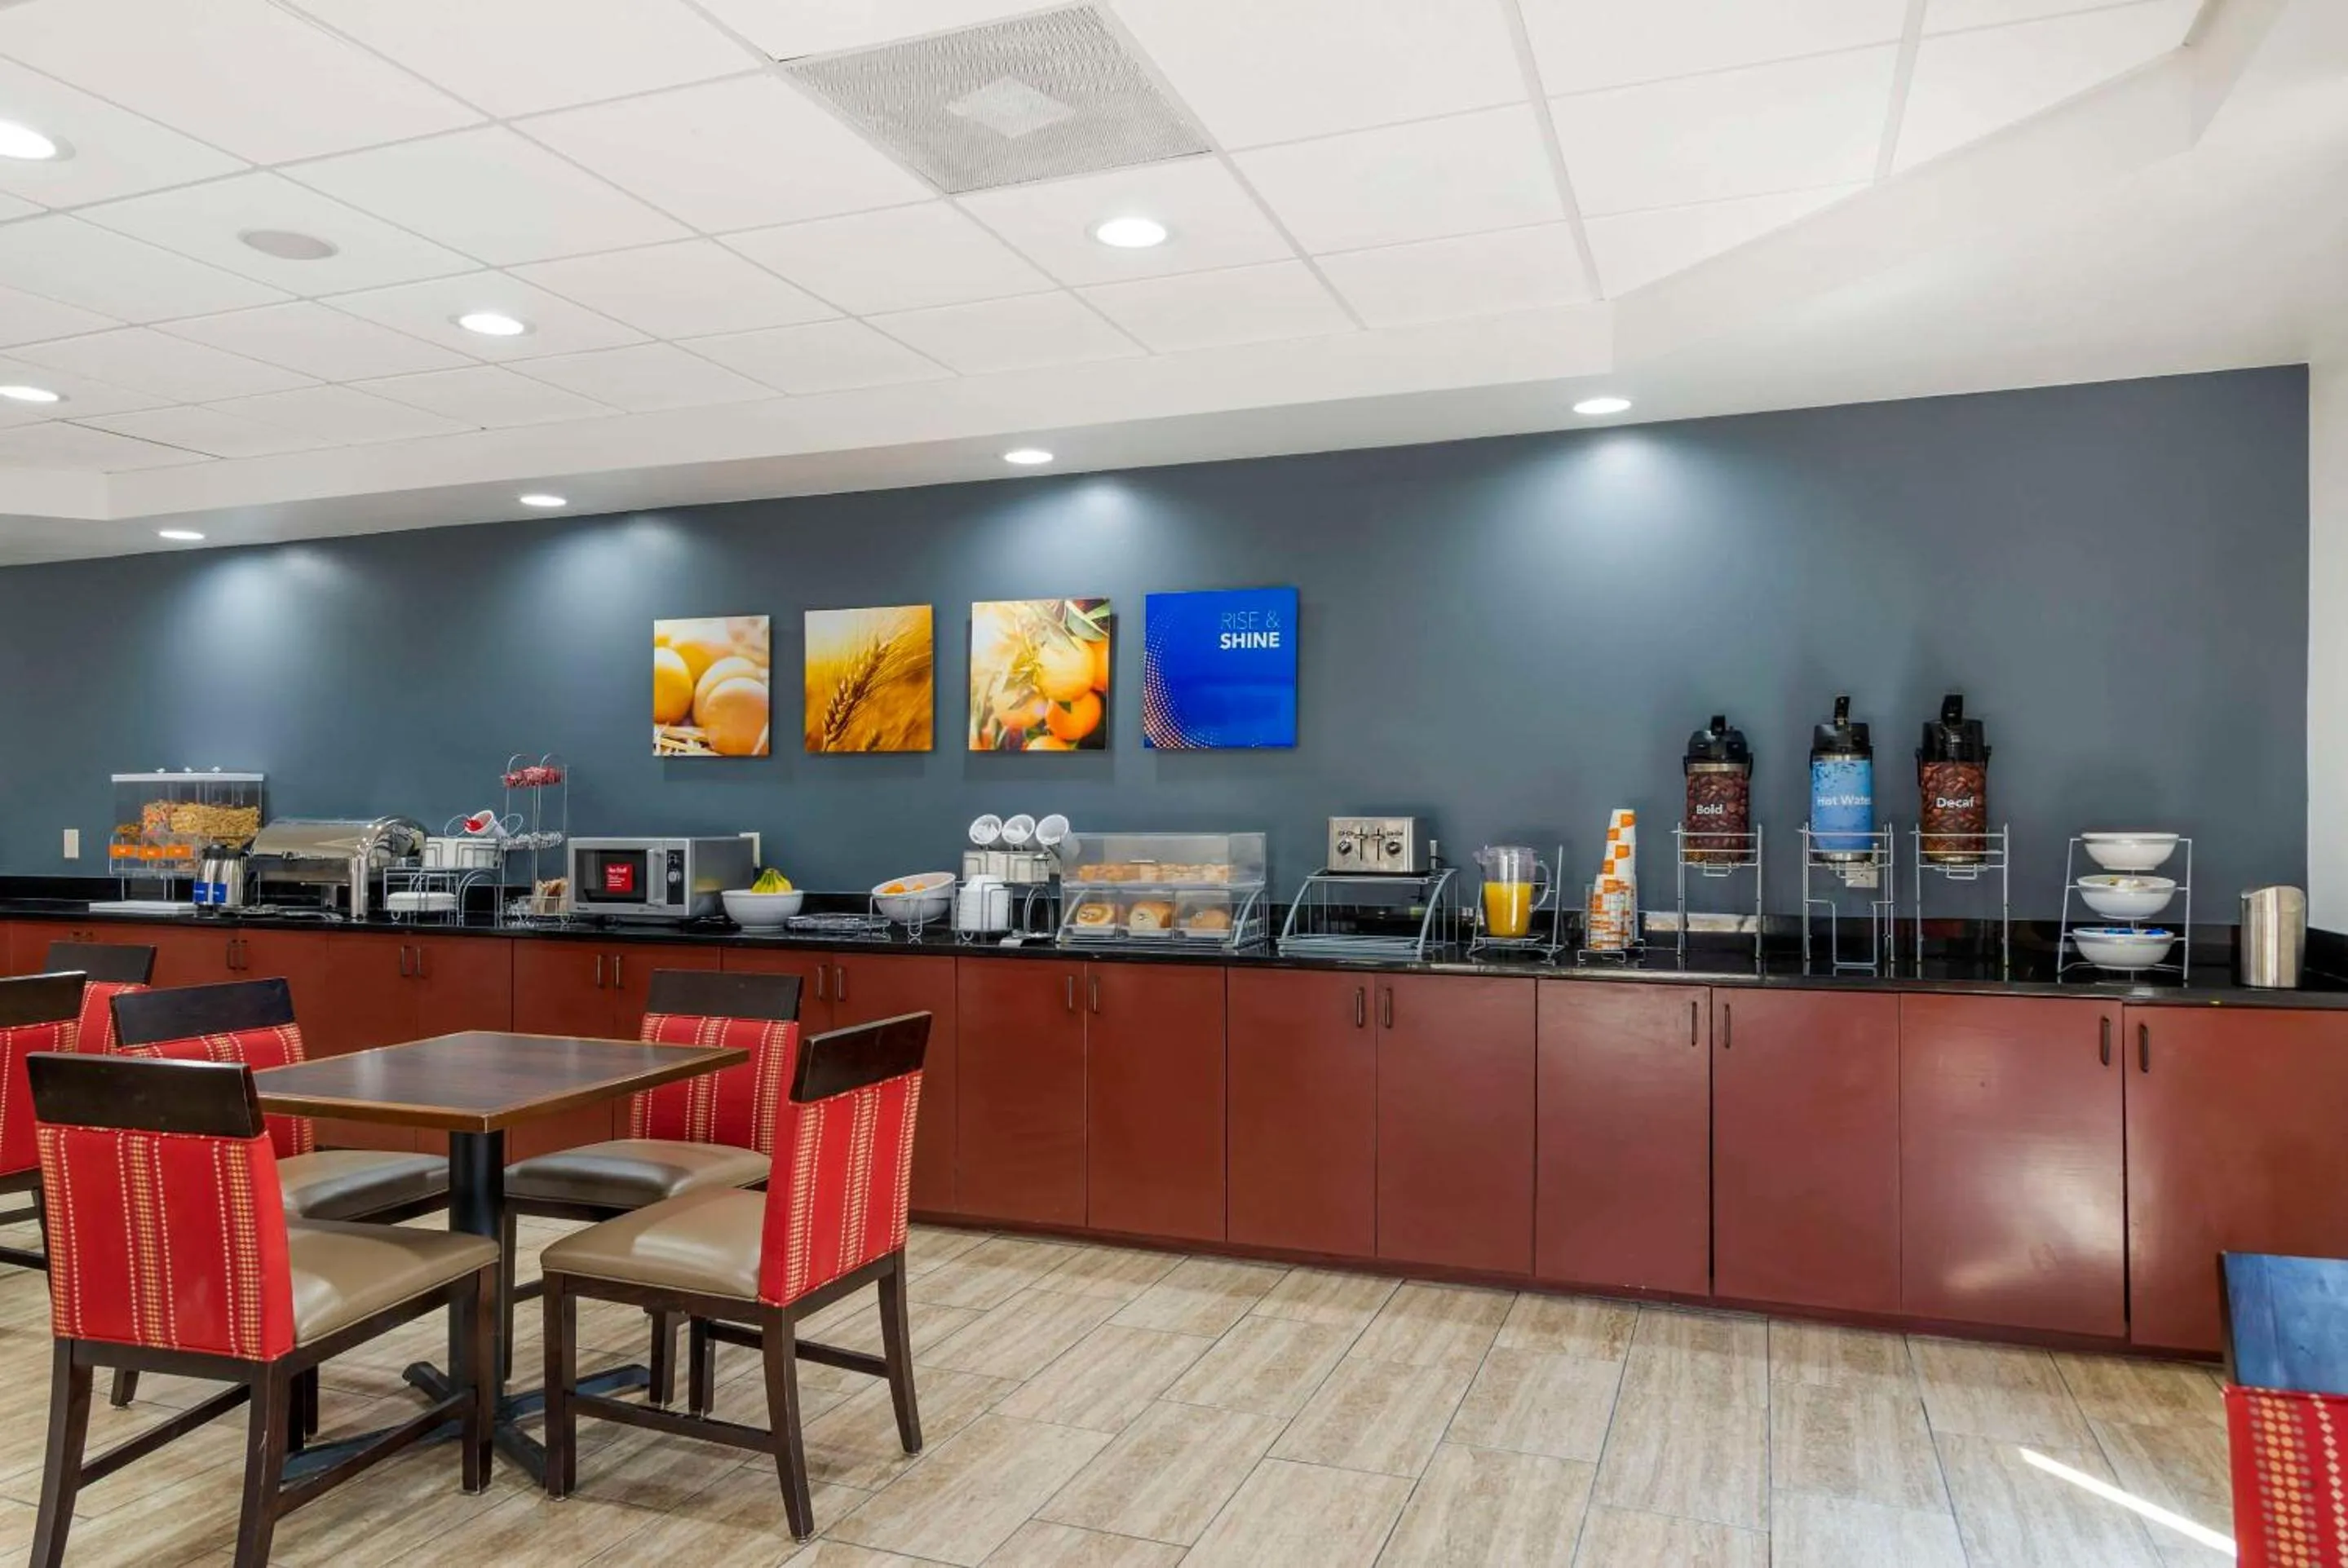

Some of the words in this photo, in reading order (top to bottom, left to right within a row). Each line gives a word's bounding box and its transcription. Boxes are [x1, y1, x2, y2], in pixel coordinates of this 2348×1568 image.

[1221, 612, 1260, 629] RISE
[1266, 610, 1281, 628] &
[1220, 632, 1280, 649] SHINE
[1817, 796, 1837, 806] Hot
[1841, 795, 1872, 806] Wate
[1936, 796, 1974, 808] Decaf
[1696, 803, 1722, 815] Bold
